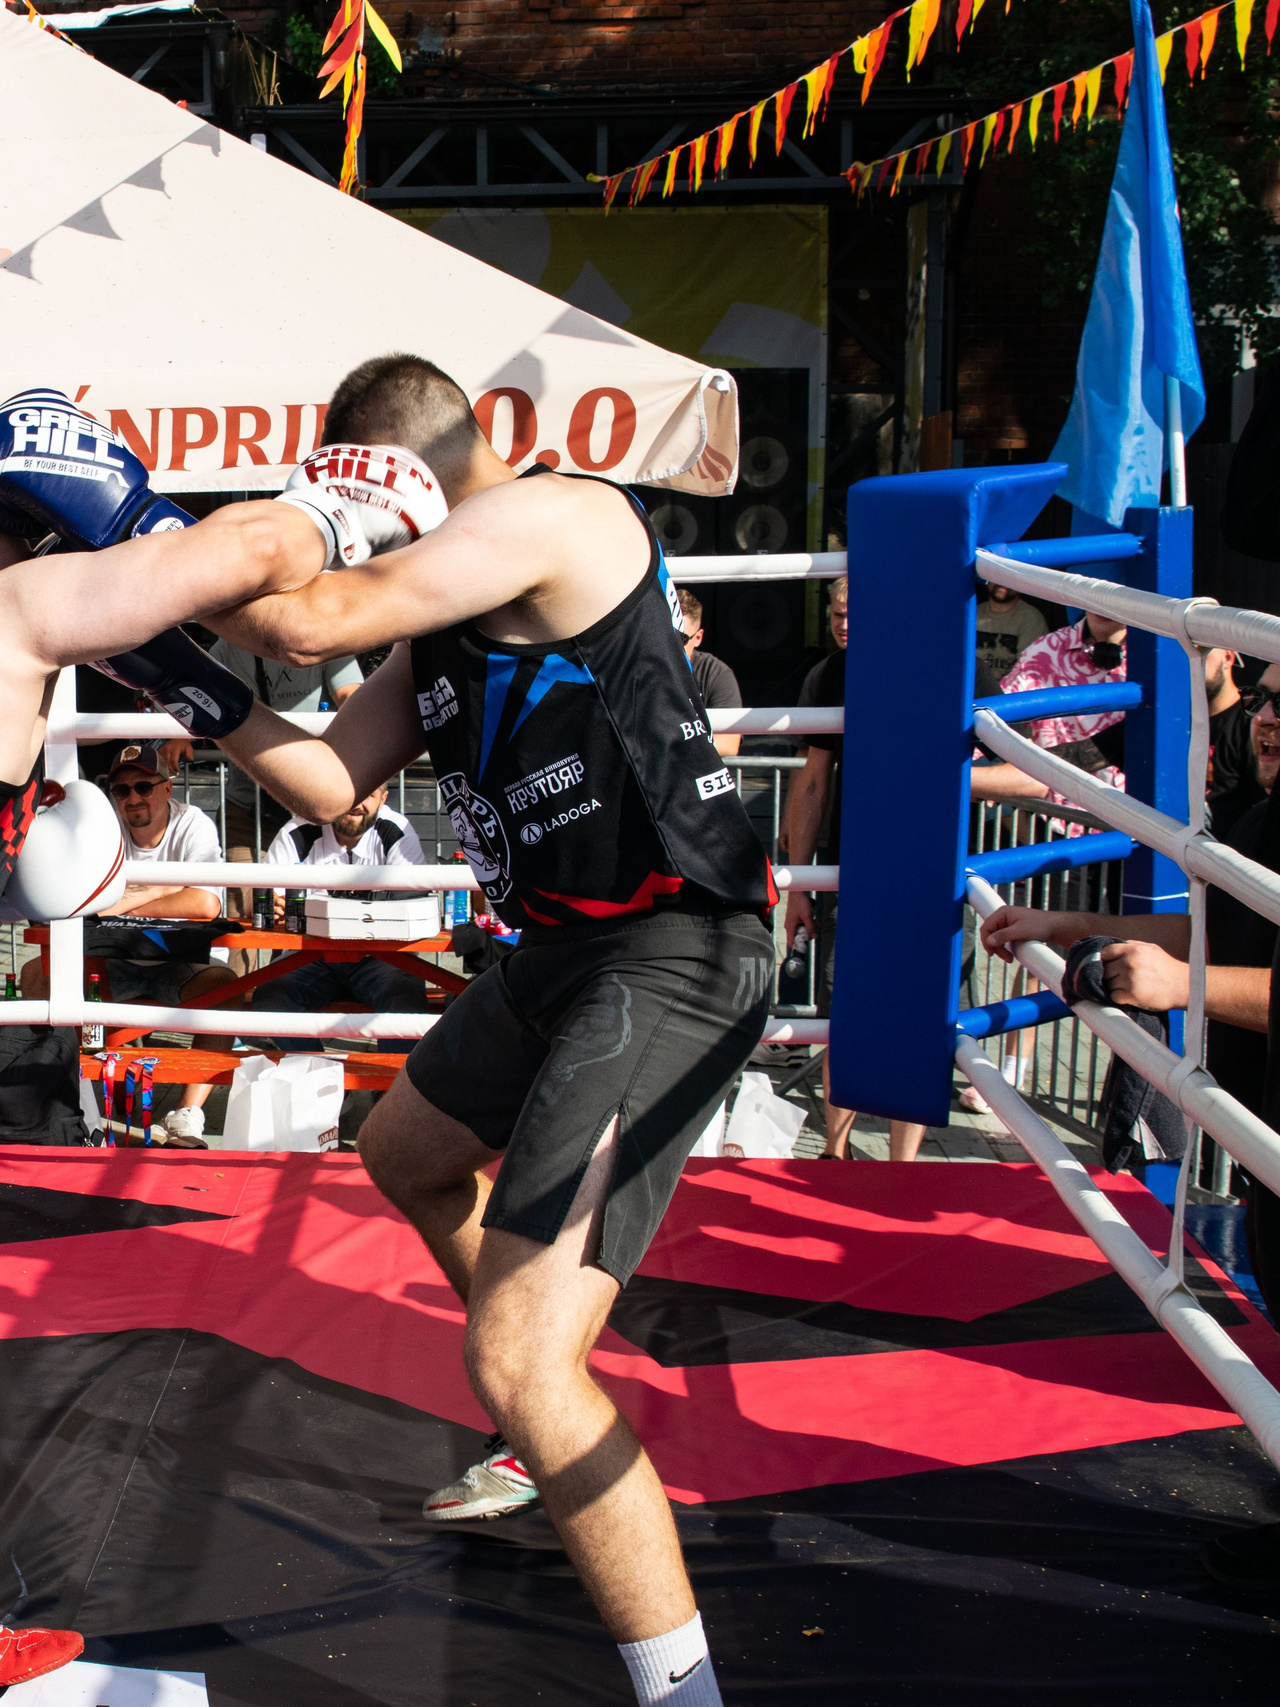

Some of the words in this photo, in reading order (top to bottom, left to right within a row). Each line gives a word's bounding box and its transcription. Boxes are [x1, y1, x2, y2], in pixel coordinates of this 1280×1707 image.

[8, 408, 127, 448] GREEN
[13, 426, 125, 469] HILL
[35, 460, 57, 471] YOUR
[58, 463, 79, 474] BEST
[301, 448, 433, 491] GREEN
[305, 458, 407, 498] HILL
[506, 760, 585, 815] КРУТОЯР
[543, 798, 602, 832] LADOGA
